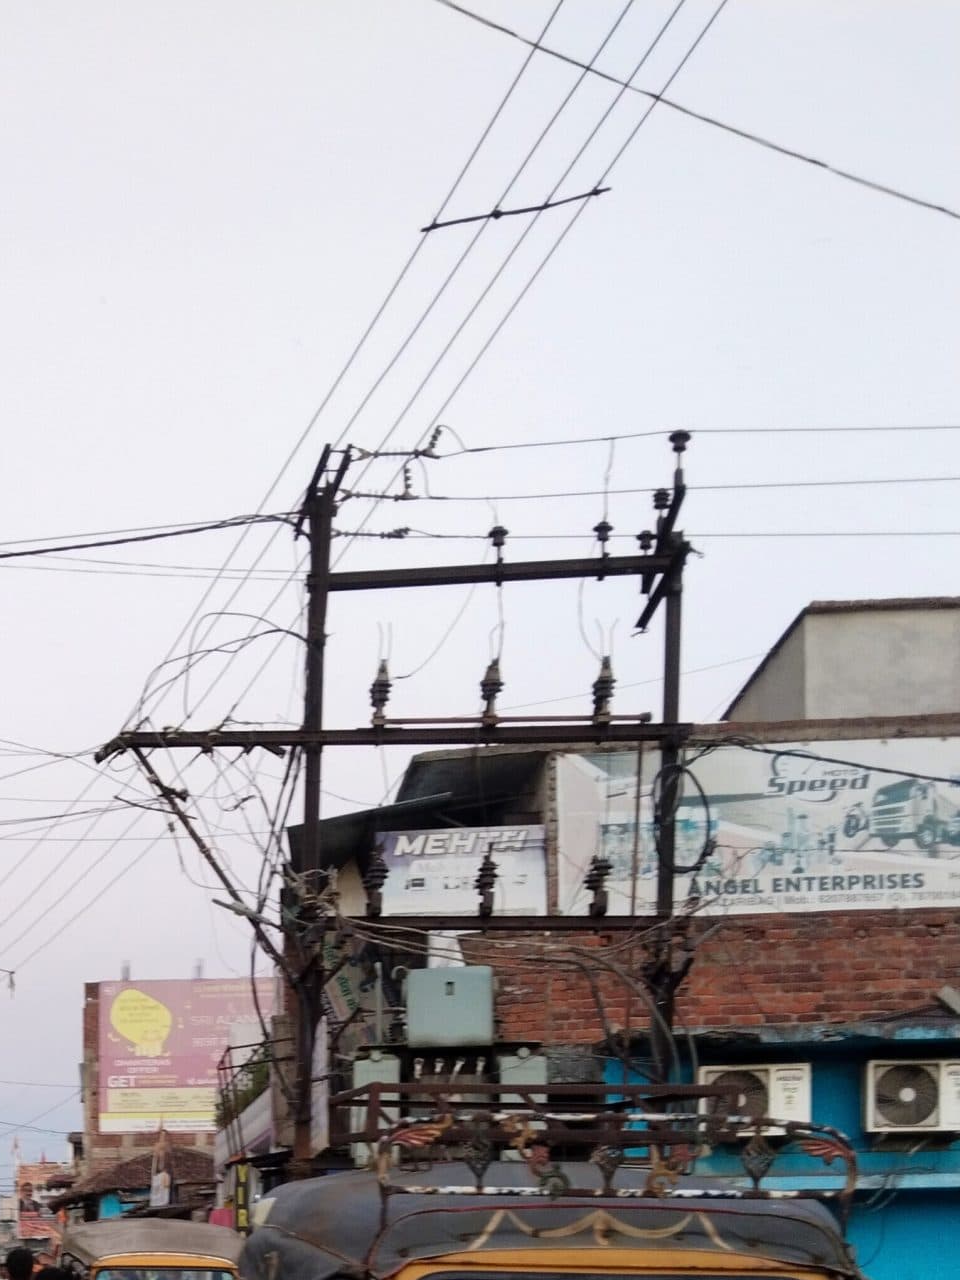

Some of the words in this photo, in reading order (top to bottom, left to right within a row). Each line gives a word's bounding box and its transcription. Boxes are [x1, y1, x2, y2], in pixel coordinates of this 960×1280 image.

[767, 773, 871, 796] Speed
[393, 830, 529, 856] MEHTA
[688, 876, 764, 897] ANGEL
[772, 872, 925, 893] ENTERPRISES
[107, 1075, 137, 1088] GET
